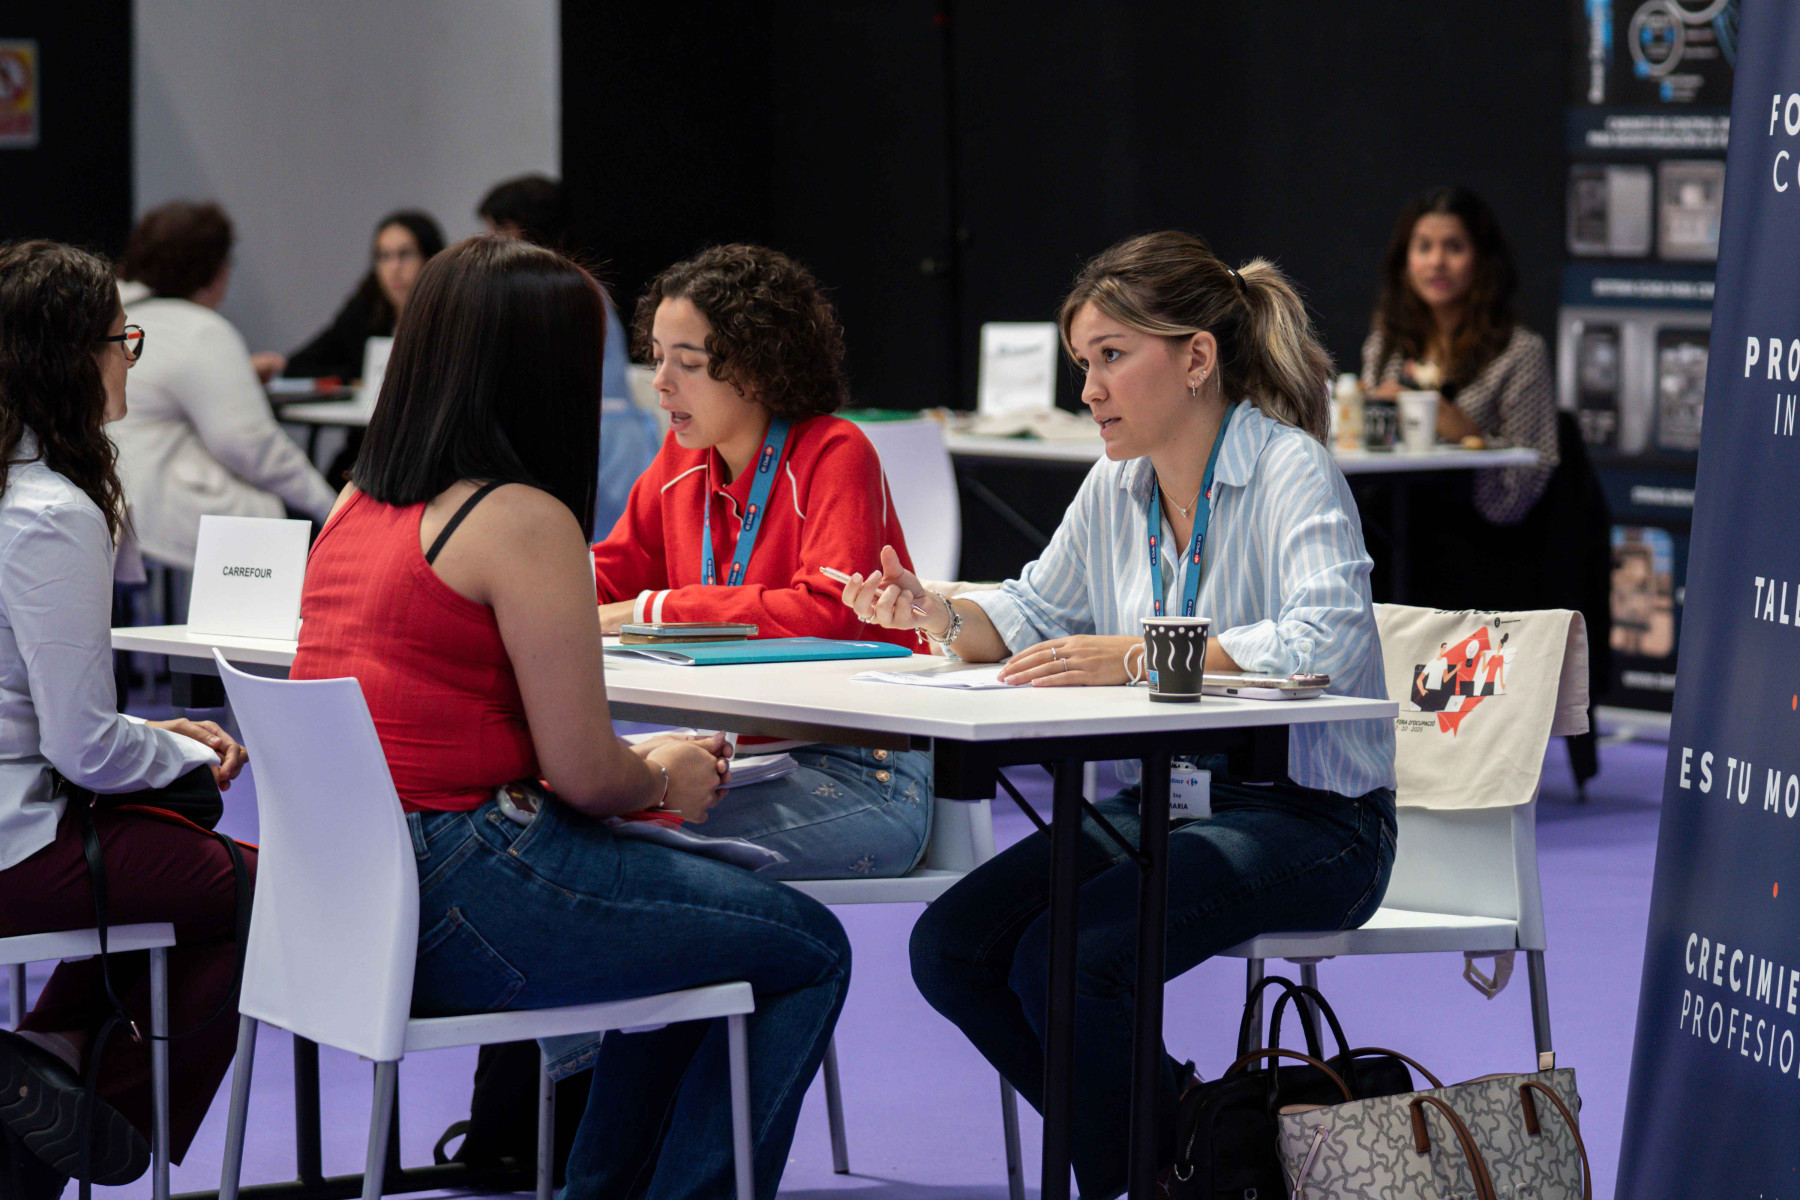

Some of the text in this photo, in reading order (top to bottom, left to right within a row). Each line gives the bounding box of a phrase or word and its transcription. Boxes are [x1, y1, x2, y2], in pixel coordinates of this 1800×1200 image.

[1773, 150, 1800, 193] C
[1744, 336, 1800, 382] PRO
[1774, 393, 1797, 436] IN
[223, 566, 272, 578] CARREFOUR
[1680, 747, 1799, 818] ES TU MO
[1686, 932, 1800, 1015] CRECIMIE
[1680, 989, 1800, 1079] PROFESIO
